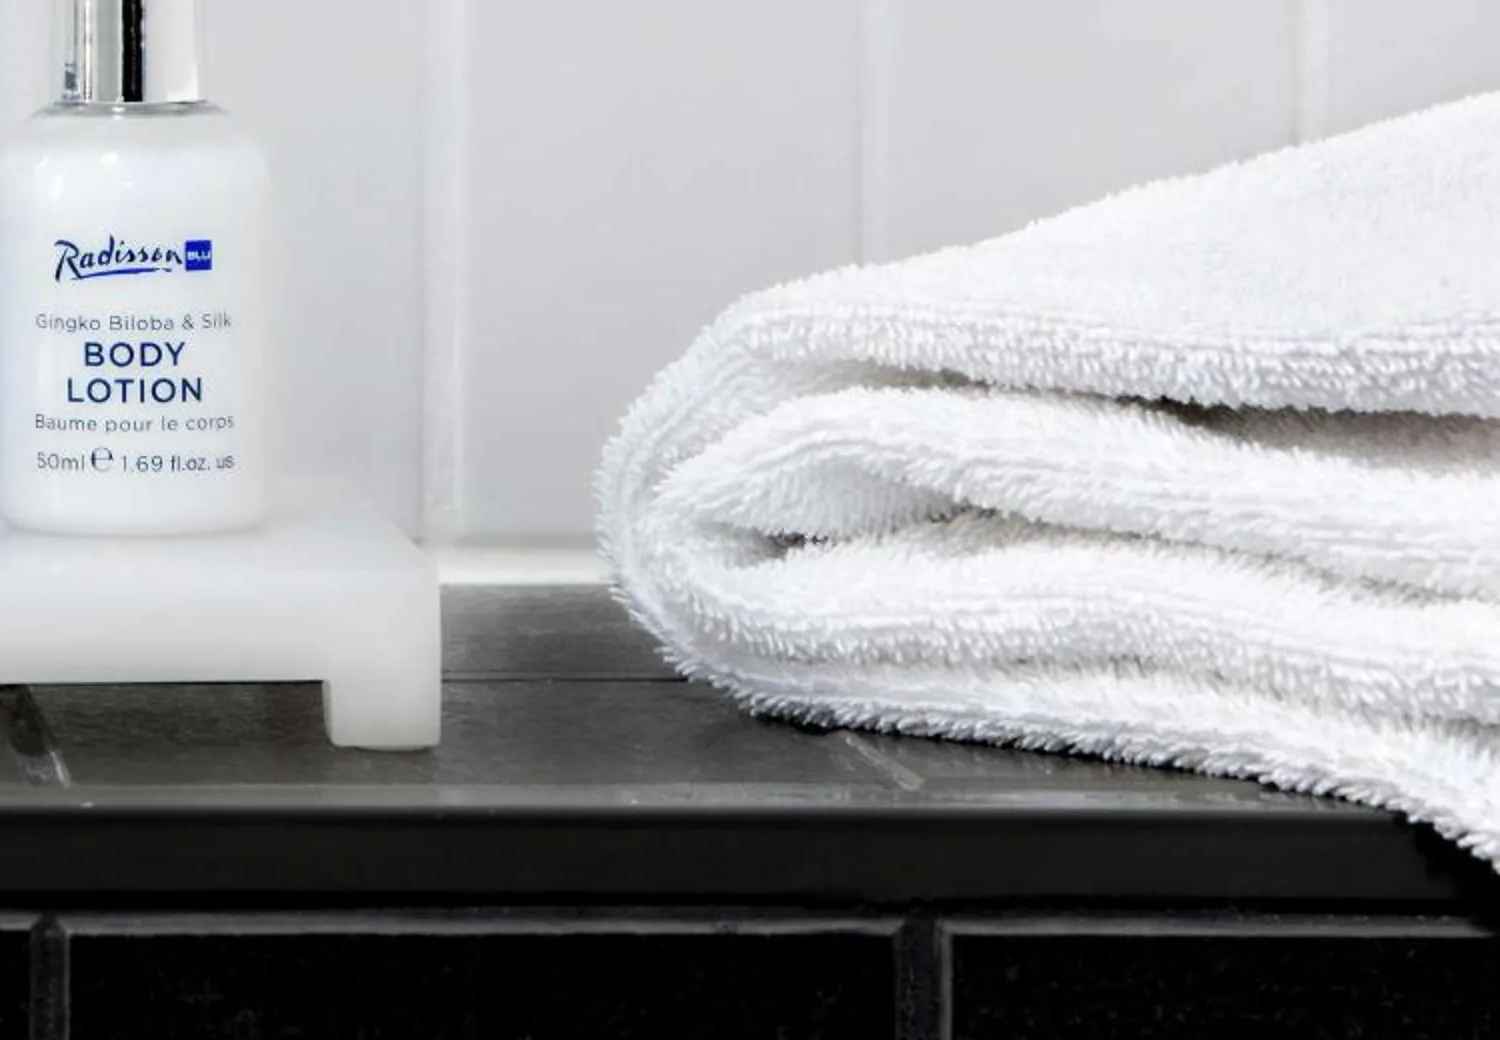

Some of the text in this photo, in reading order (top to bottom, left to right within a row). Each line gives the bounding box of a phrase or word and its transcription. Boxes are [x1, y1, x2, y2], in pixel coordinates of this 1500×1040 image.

[55, 234, 182, 282] Radisson
[35, 313, 232, 333] Gingko Biloba & Silk
[84, 341, 186, 367] BODY
[67, 377, 203, 403] LOTION
[35, 414, 235, 435] Baume pour le corps
[36, 451, 85, 471] 50ml
[122, 455, 163, 473] 1.69
[216, 454, 236, 469] us
